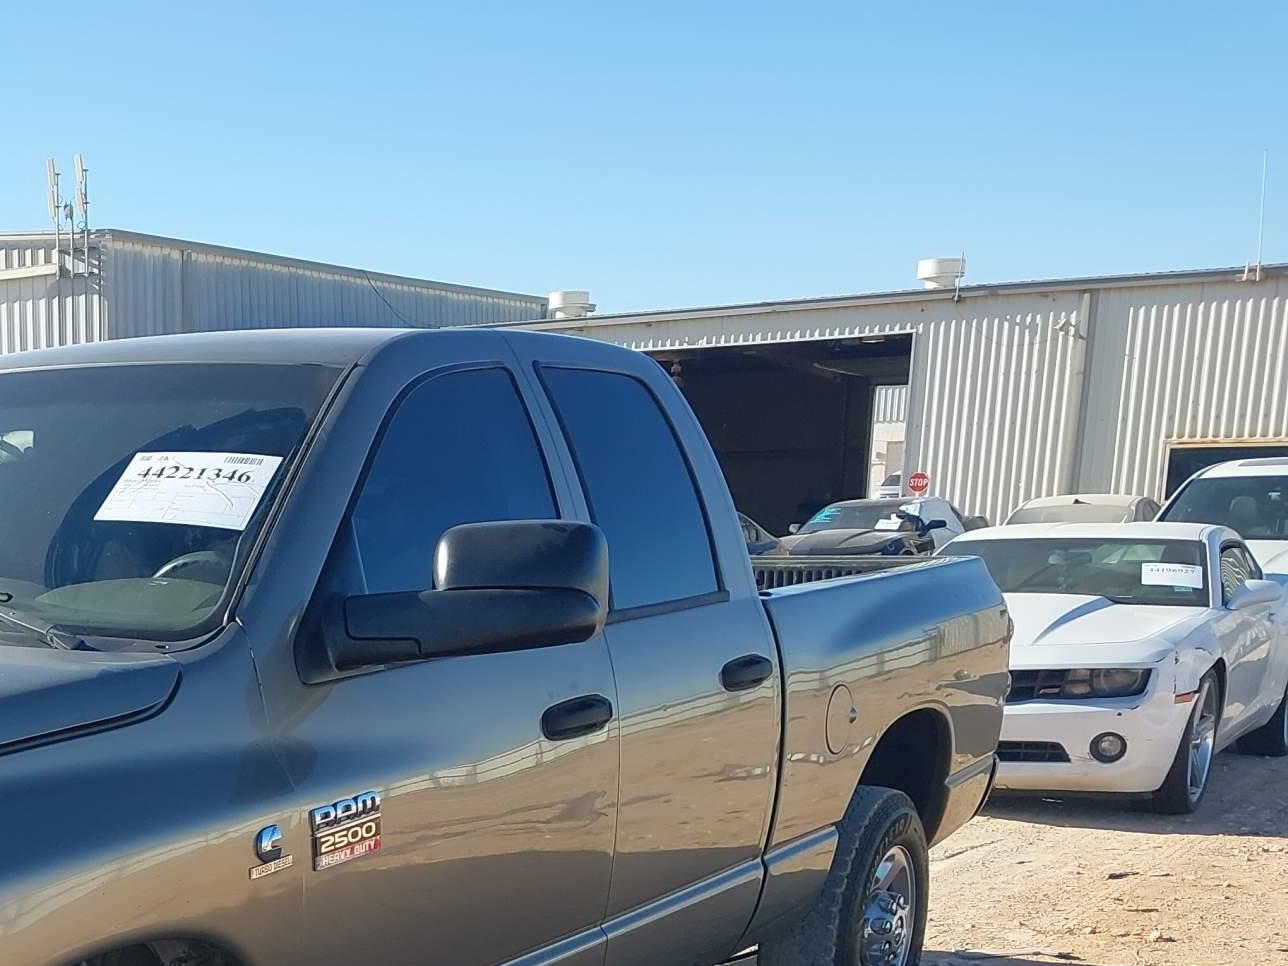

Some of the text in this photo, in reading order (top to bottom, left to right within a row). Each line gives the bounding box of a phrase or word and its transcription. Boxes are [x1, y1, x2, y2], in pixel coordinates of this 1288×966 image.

[137, 465, 254, 483] 44221346
[909, 478, 928, 487] STOP
[312, 791, 381, 827] RAM
[320, 821, 376, 854] 2500
[322, 839, 376, 866] HEAVY DUTY
[254, 856, 291, 876] TURBO DIESEL
